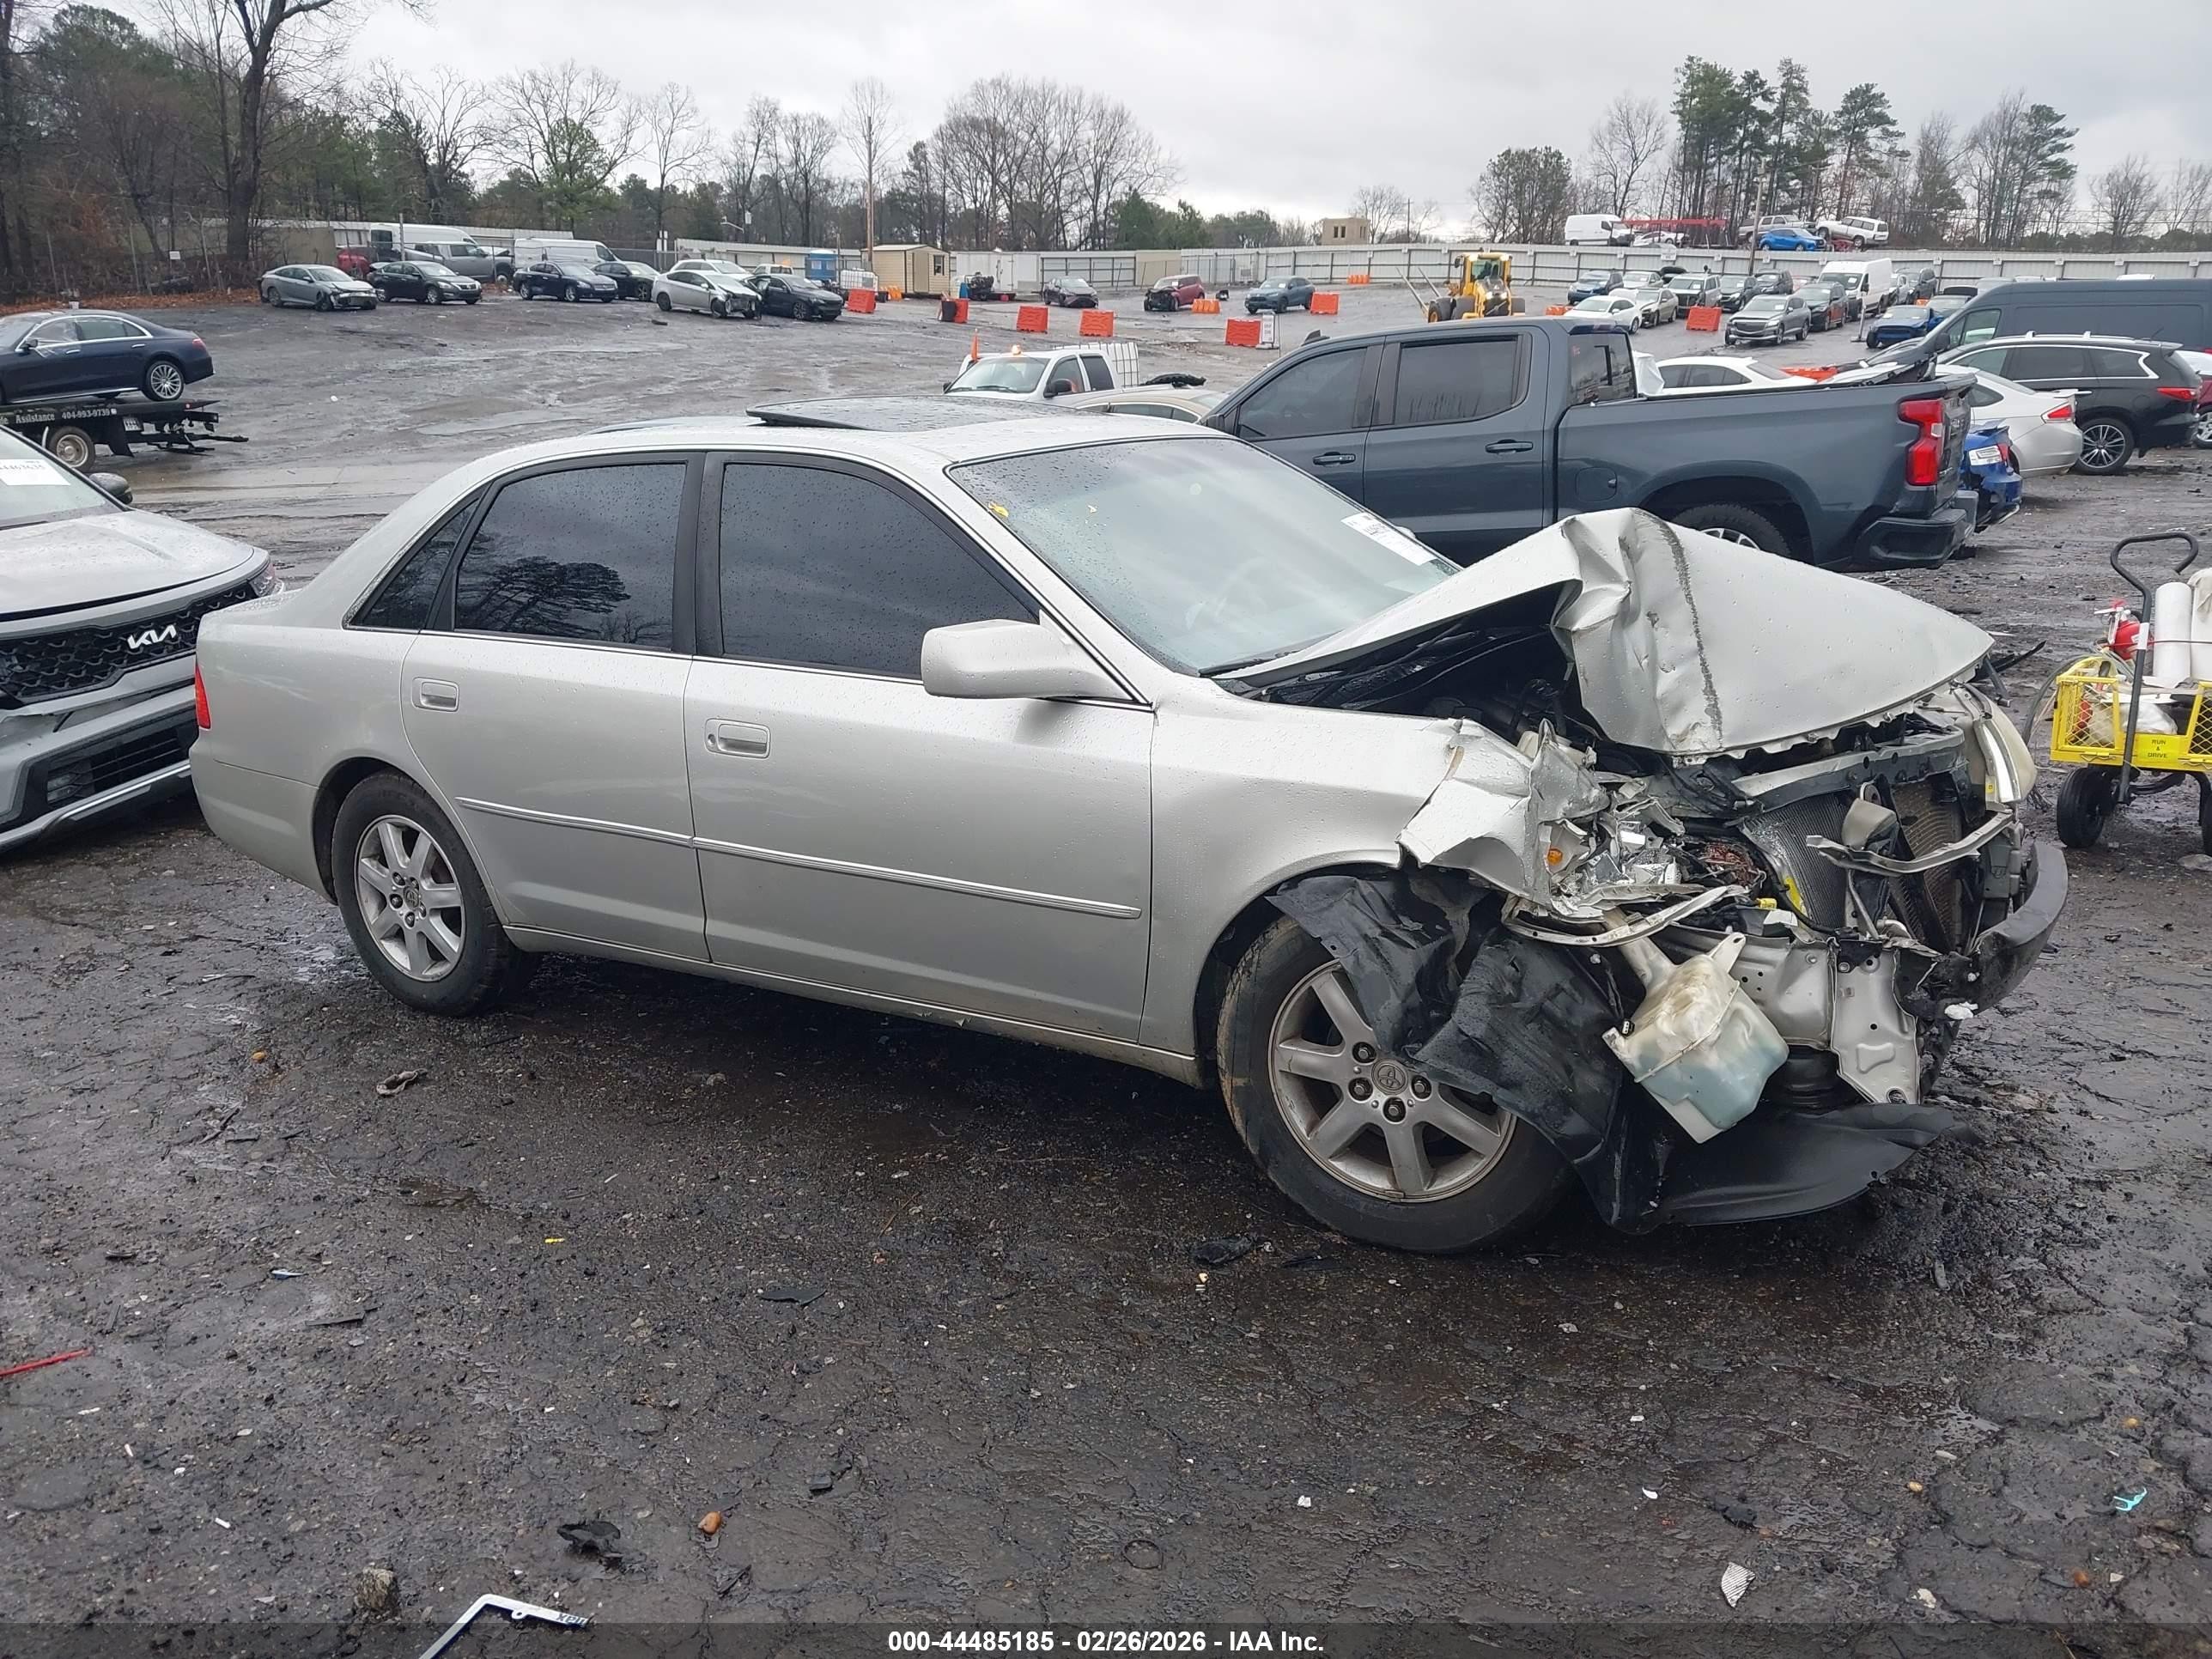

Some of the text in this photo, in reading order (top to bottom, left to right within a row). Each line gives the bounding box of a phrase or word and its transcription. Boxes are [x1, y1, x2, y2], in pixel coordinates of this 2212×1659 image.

[15, 413, 55, 423] Assistance
[62, 409, 111, 419] 404-993-9739
[127, 624, 177, 649] KIA
